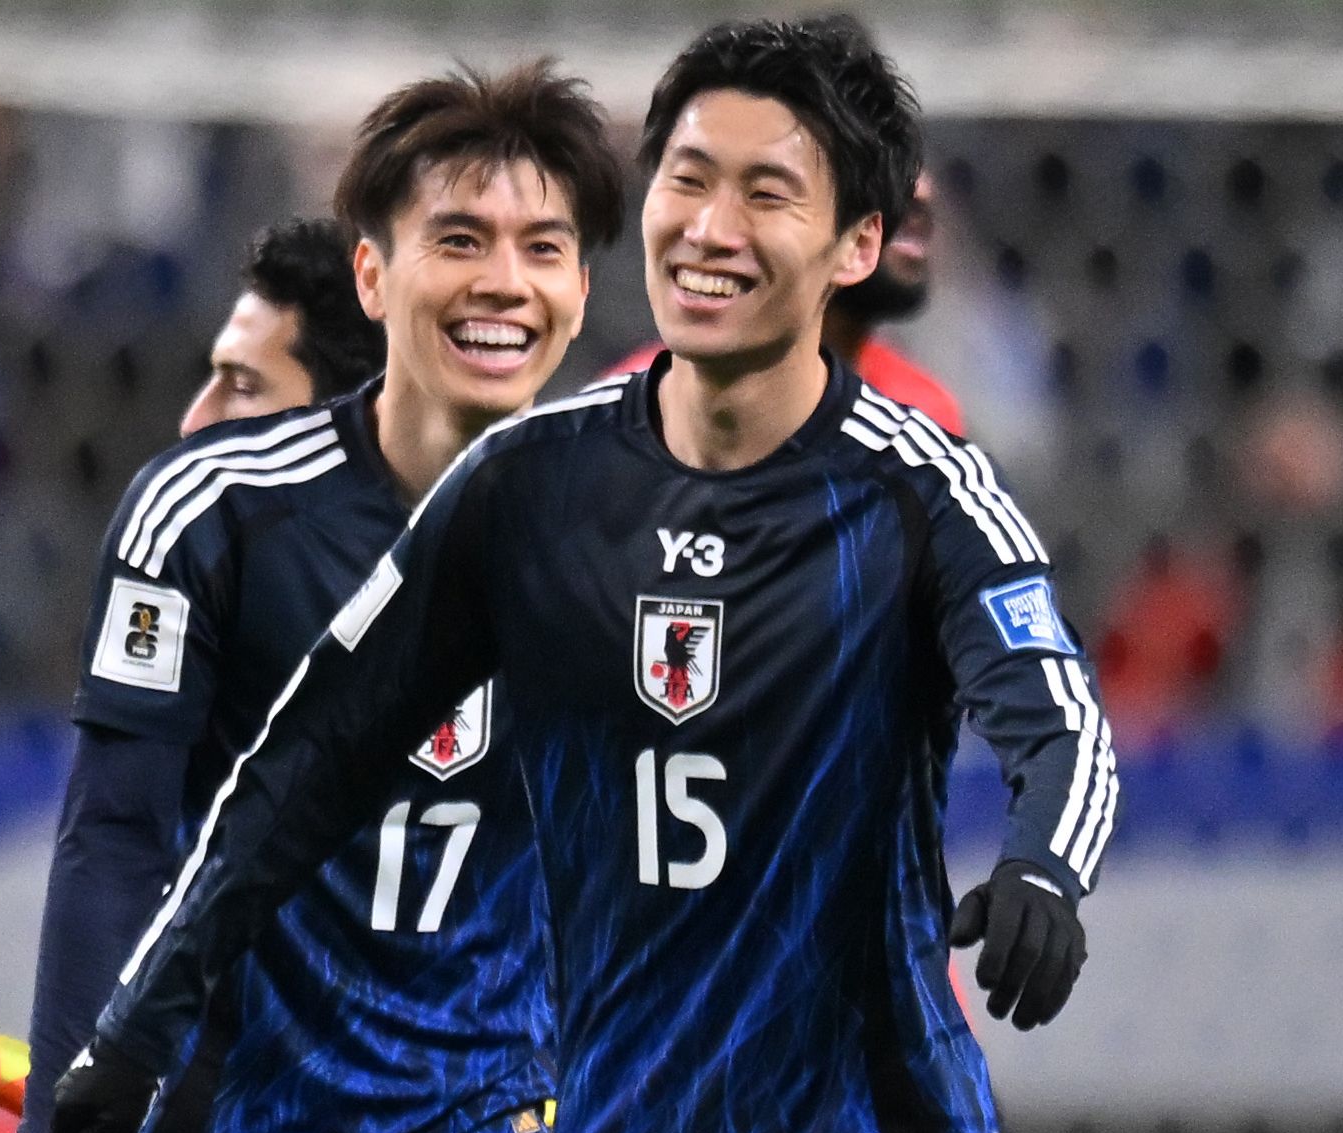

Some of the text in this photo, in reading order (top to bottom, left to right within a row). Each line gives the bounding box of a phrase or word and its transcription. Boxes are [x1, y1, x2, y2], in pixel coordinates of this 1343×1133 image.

[656, 527, 725, 577] Y-3
[658, 603, 703, 617] JAPAN
[634, 747, 728, 891] 15
[371, 800, 481, 933] 17
